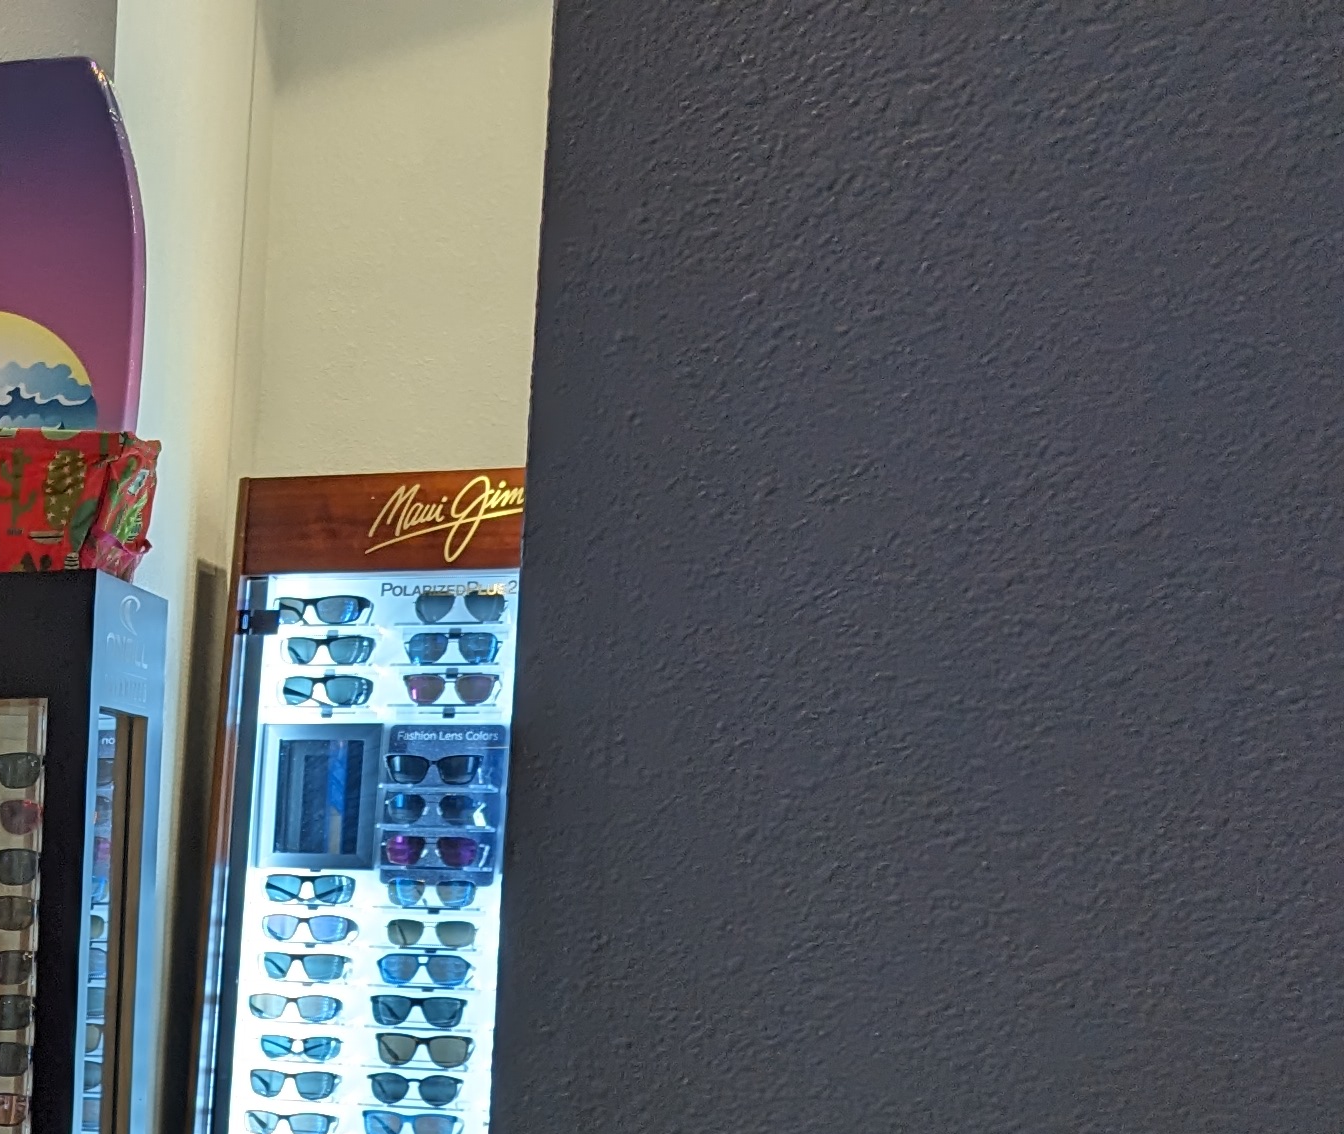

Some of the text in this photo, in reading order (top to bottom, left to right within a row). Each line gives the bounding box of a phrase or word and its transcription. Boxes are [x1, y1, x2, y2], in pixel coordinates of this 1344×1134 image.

[368, 475, 525, 563] Maui Jim
[397, 730, 499, 741] Fashion Lens Colors
